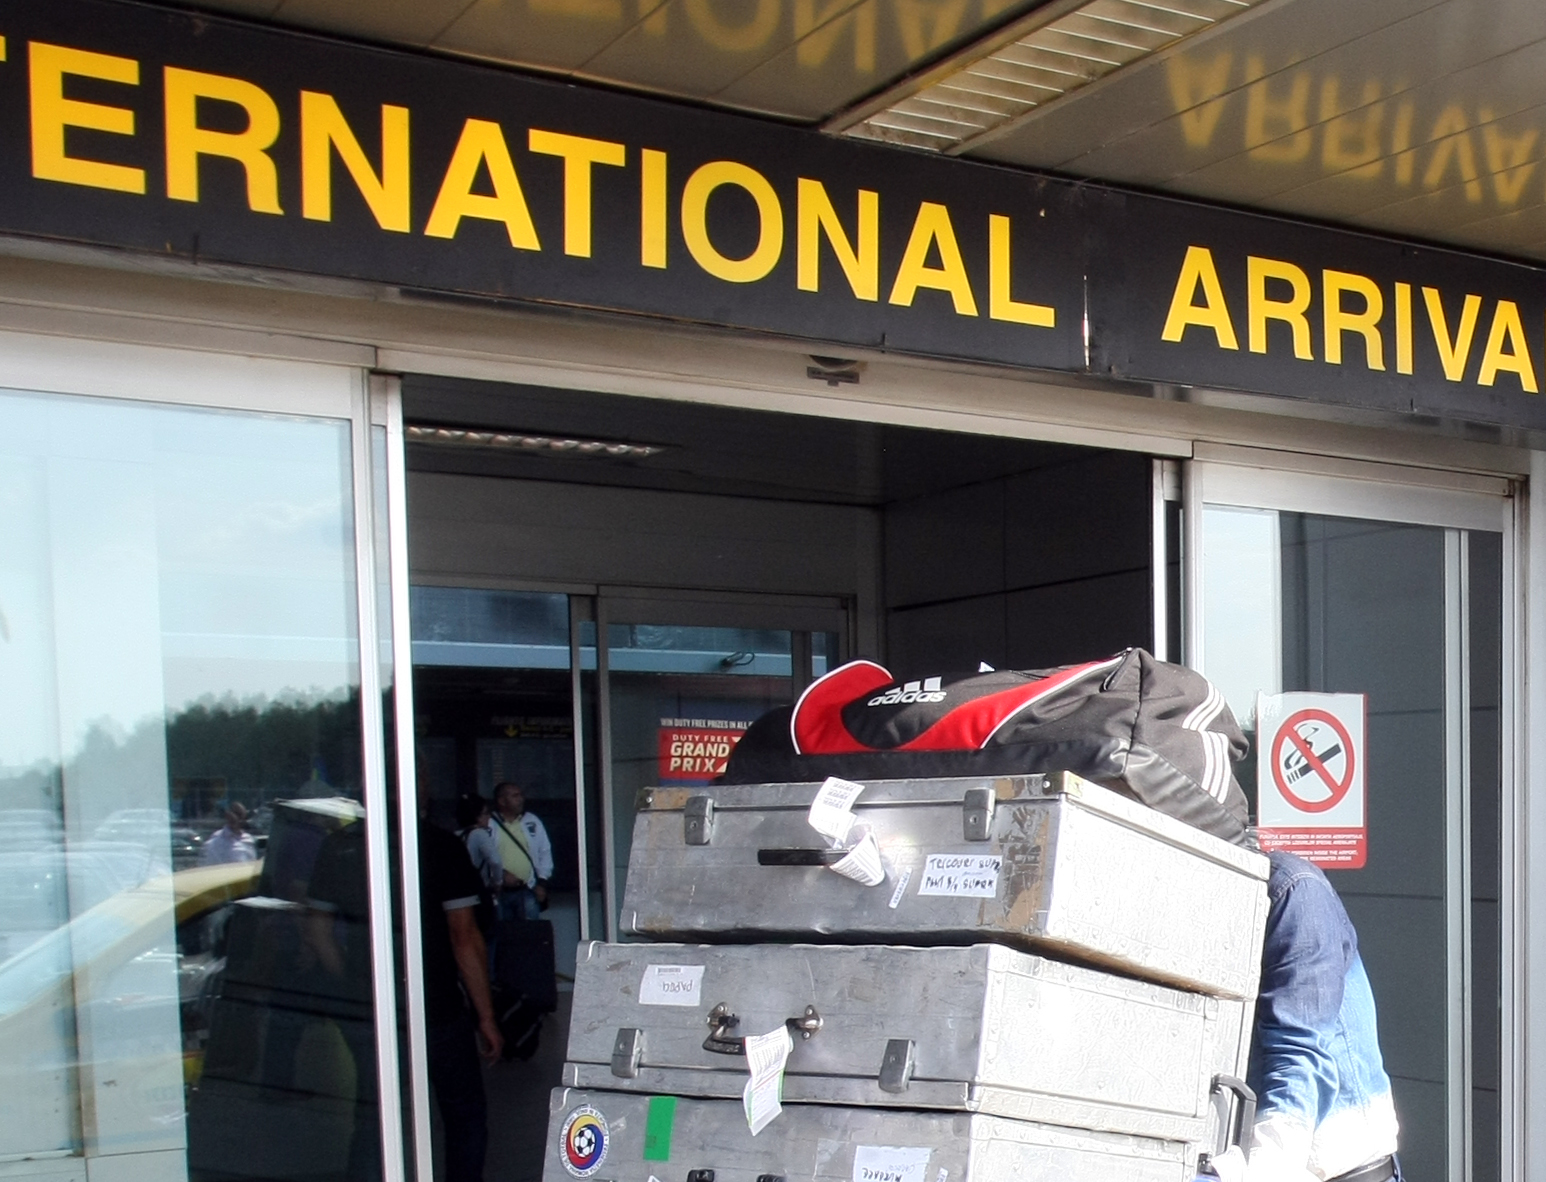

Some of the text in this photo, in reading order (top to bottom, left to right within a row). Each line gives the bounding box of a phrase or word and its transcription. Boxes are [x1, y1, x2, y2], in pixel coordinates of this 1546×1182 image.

[0, 35, 1055, 329] ERNATIONAL
[867, 689, 947, 707] adidas
[674, 718, 691, 728] DUTY
[691, 719, 707, 728] FREE
[672, 734, 729, 743] DUTY FREE
[670, 742, 730, 758] GRAND
[669, 757, 716, 773] PRIX
